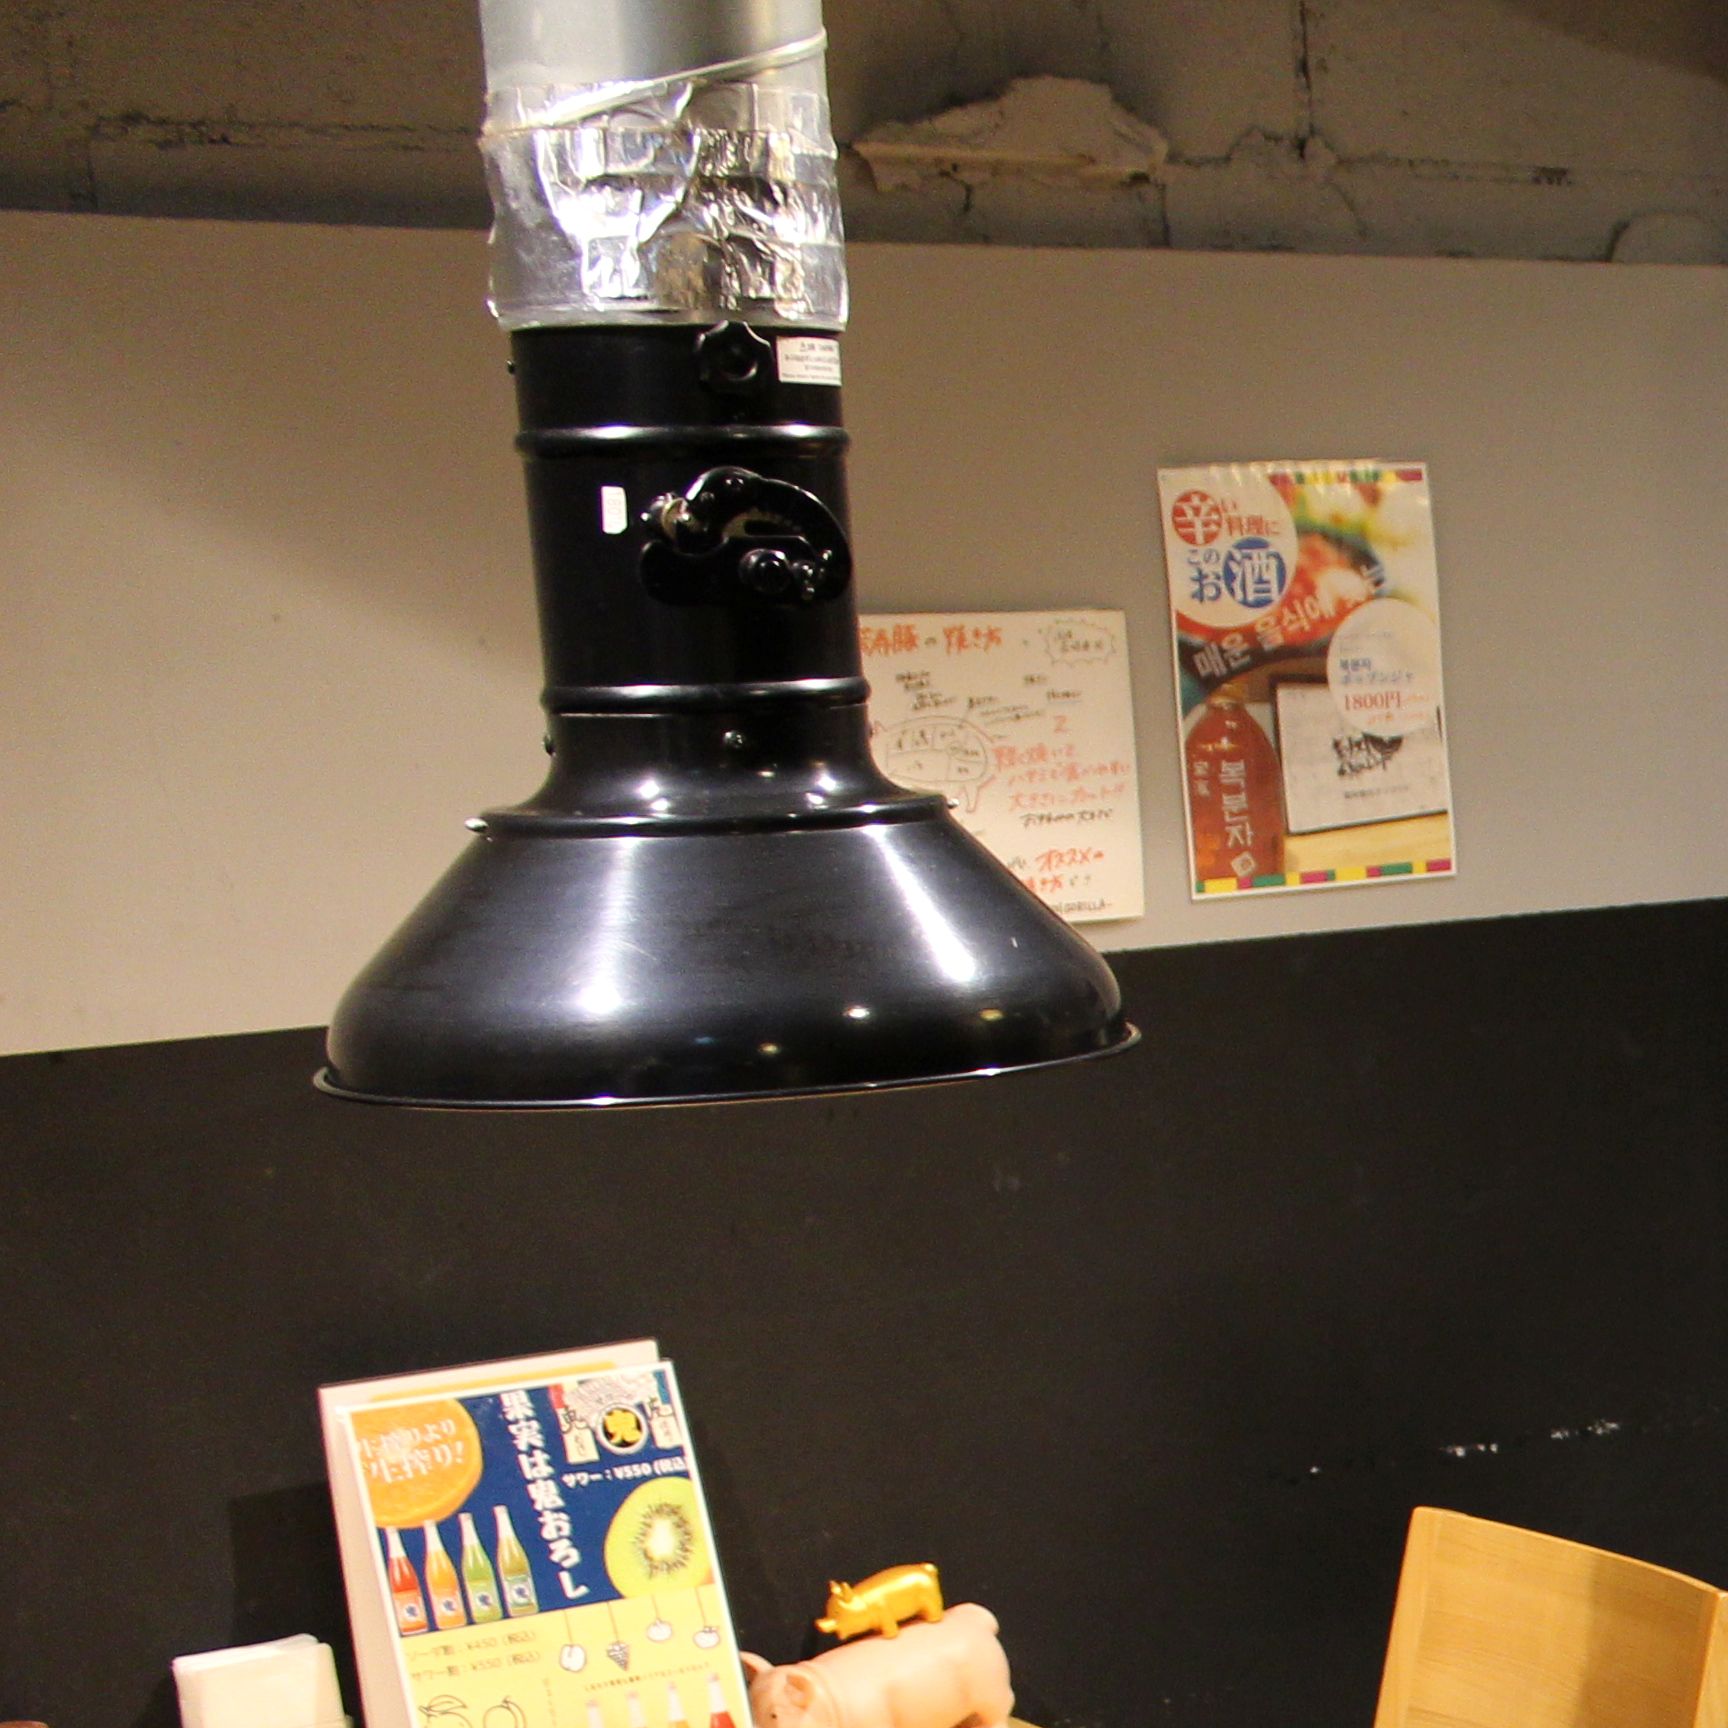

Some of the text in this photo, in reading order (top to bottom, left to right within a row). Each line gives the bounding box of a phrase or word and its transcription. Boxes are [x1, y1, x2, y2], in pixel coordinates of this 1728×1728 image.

[1186, 549, 1222, 566] この
[501, 1389, 591, 1600] 果実は鬼おろし
